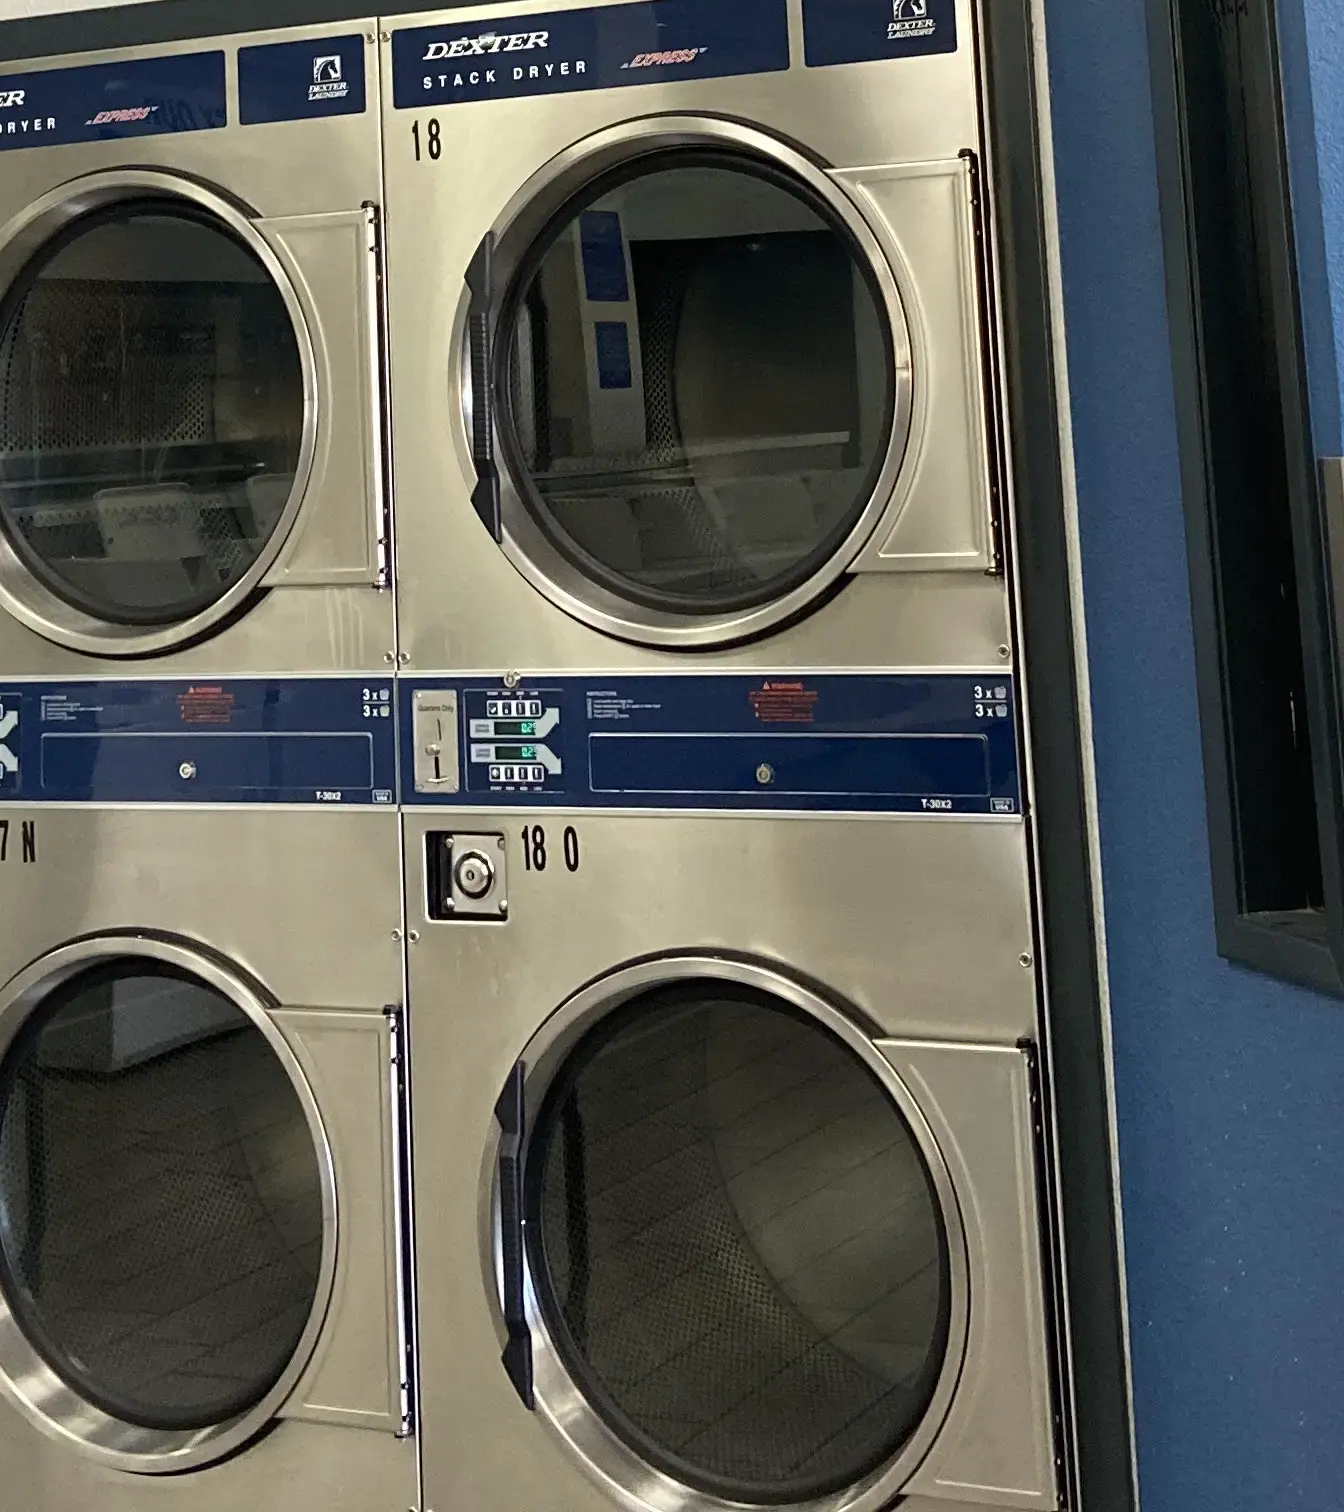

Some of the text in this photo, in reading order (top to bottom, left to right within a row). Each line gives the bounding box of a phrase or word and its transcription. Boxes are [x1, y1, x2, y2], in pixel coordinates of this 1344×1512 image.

[887, 19, 934, 32] DEXTER
[422, 31, 549, 61] DEXTER
[423, 61, 587, 89] STACK DRYER
[412, 118, 442, 162] 18
[362, 688, 370, 700] 3
[974, 685, 992, 699] 3 x
[363, 705, 371, 717] 3
[975, 704, 994, 717] 3 x
[22, 821, 36, 864] N
[521, 824, 546, 872] 18
